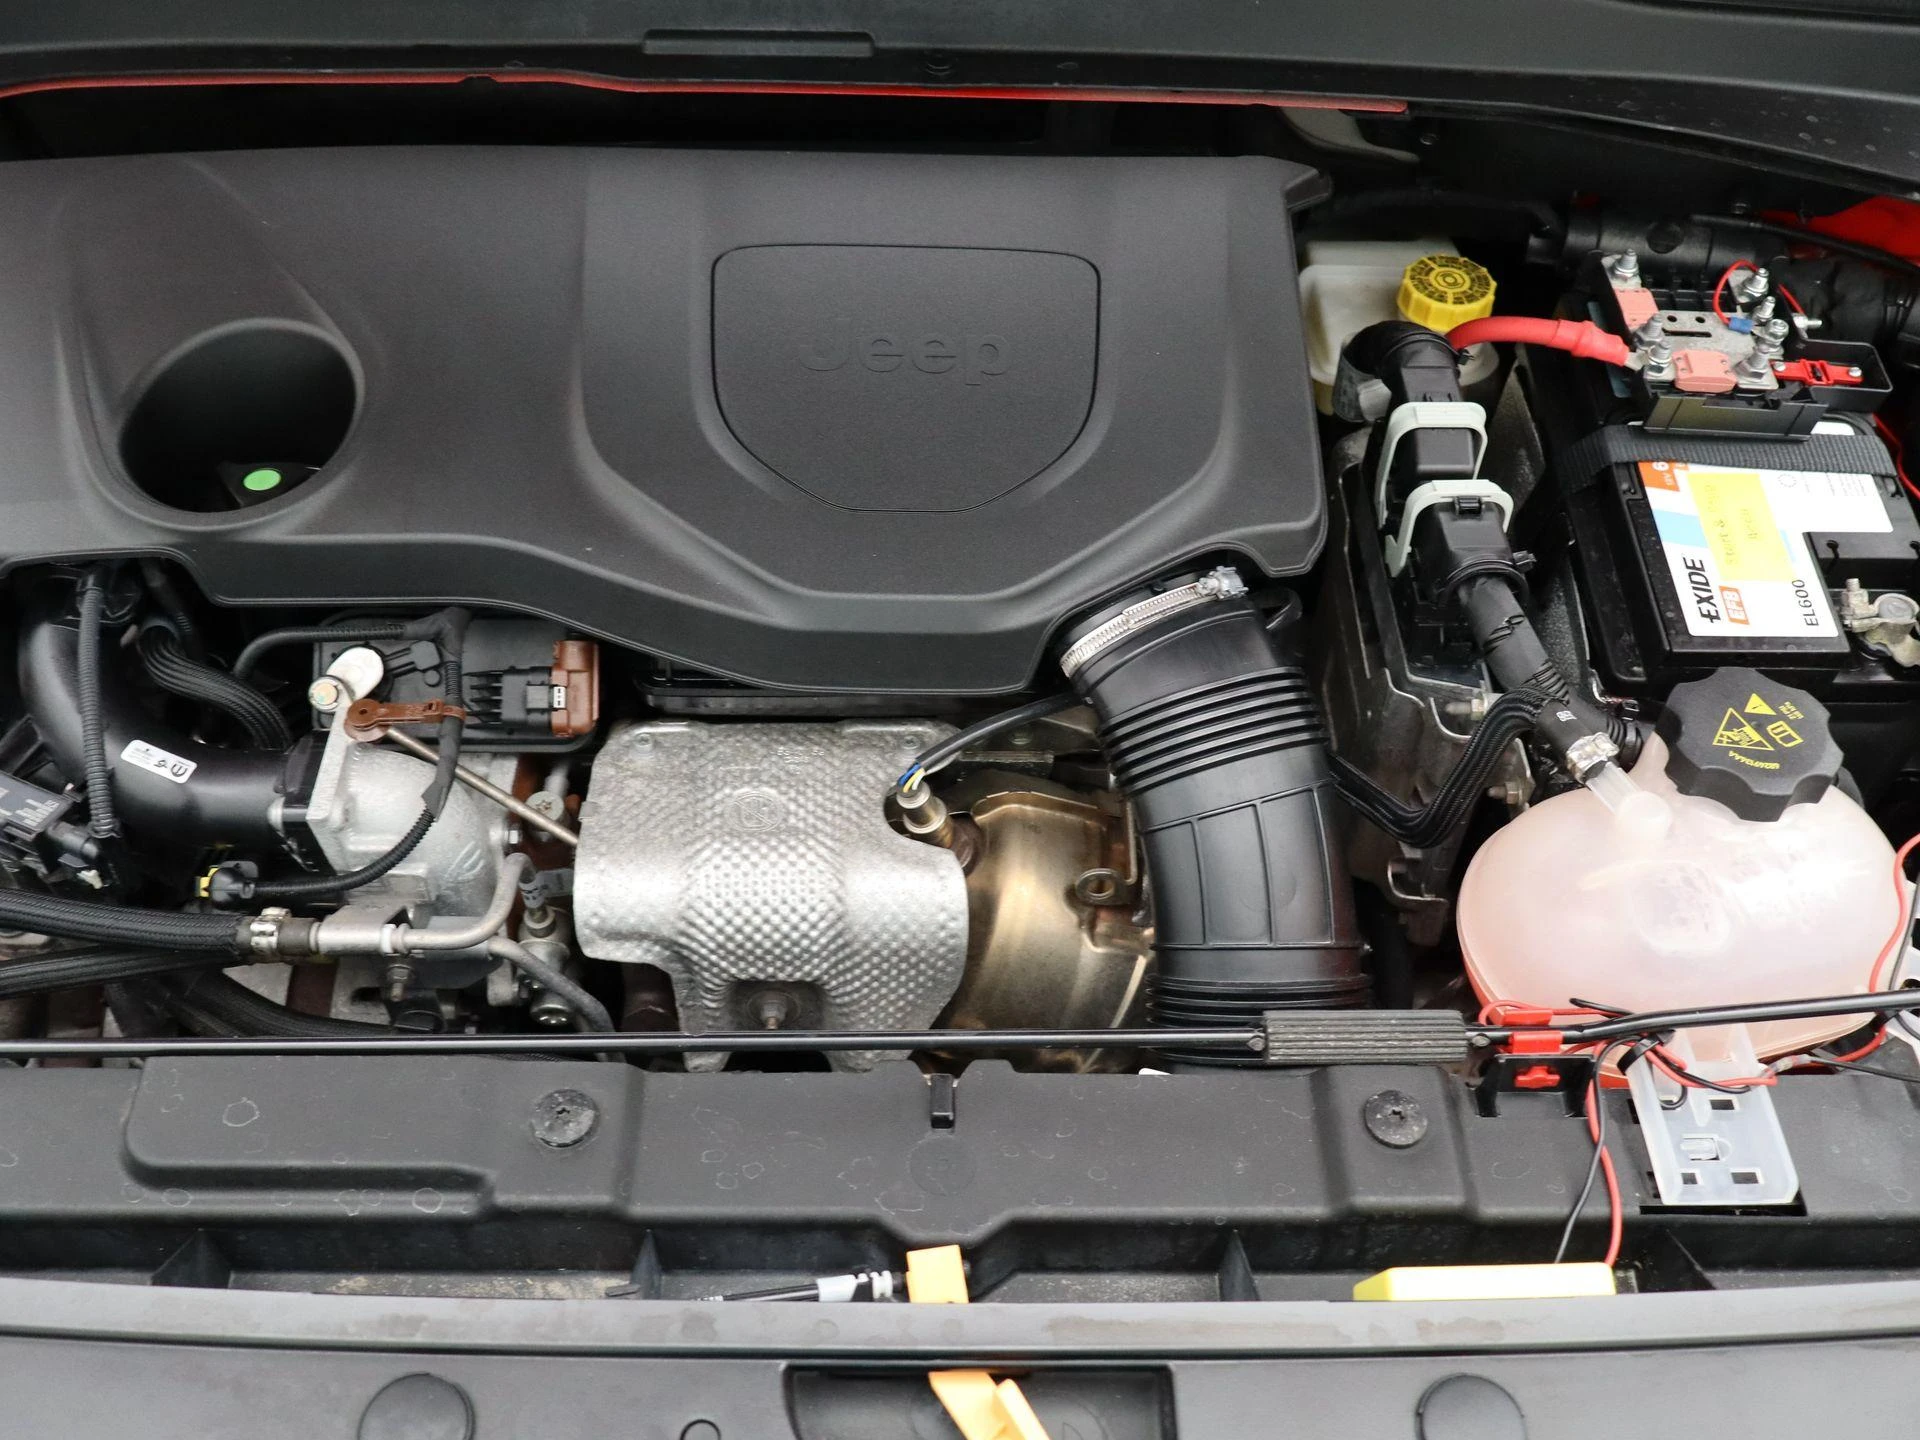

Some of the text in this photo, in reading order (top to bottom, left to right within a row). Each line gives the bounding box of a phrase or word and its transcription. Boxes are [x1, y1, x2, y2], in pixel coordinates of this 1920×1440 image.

[798, 317, 1009, 386] Jeep
[1683, 557, 1721, 624] EXIDE
[1791, 580, 1819, 627] EL600
